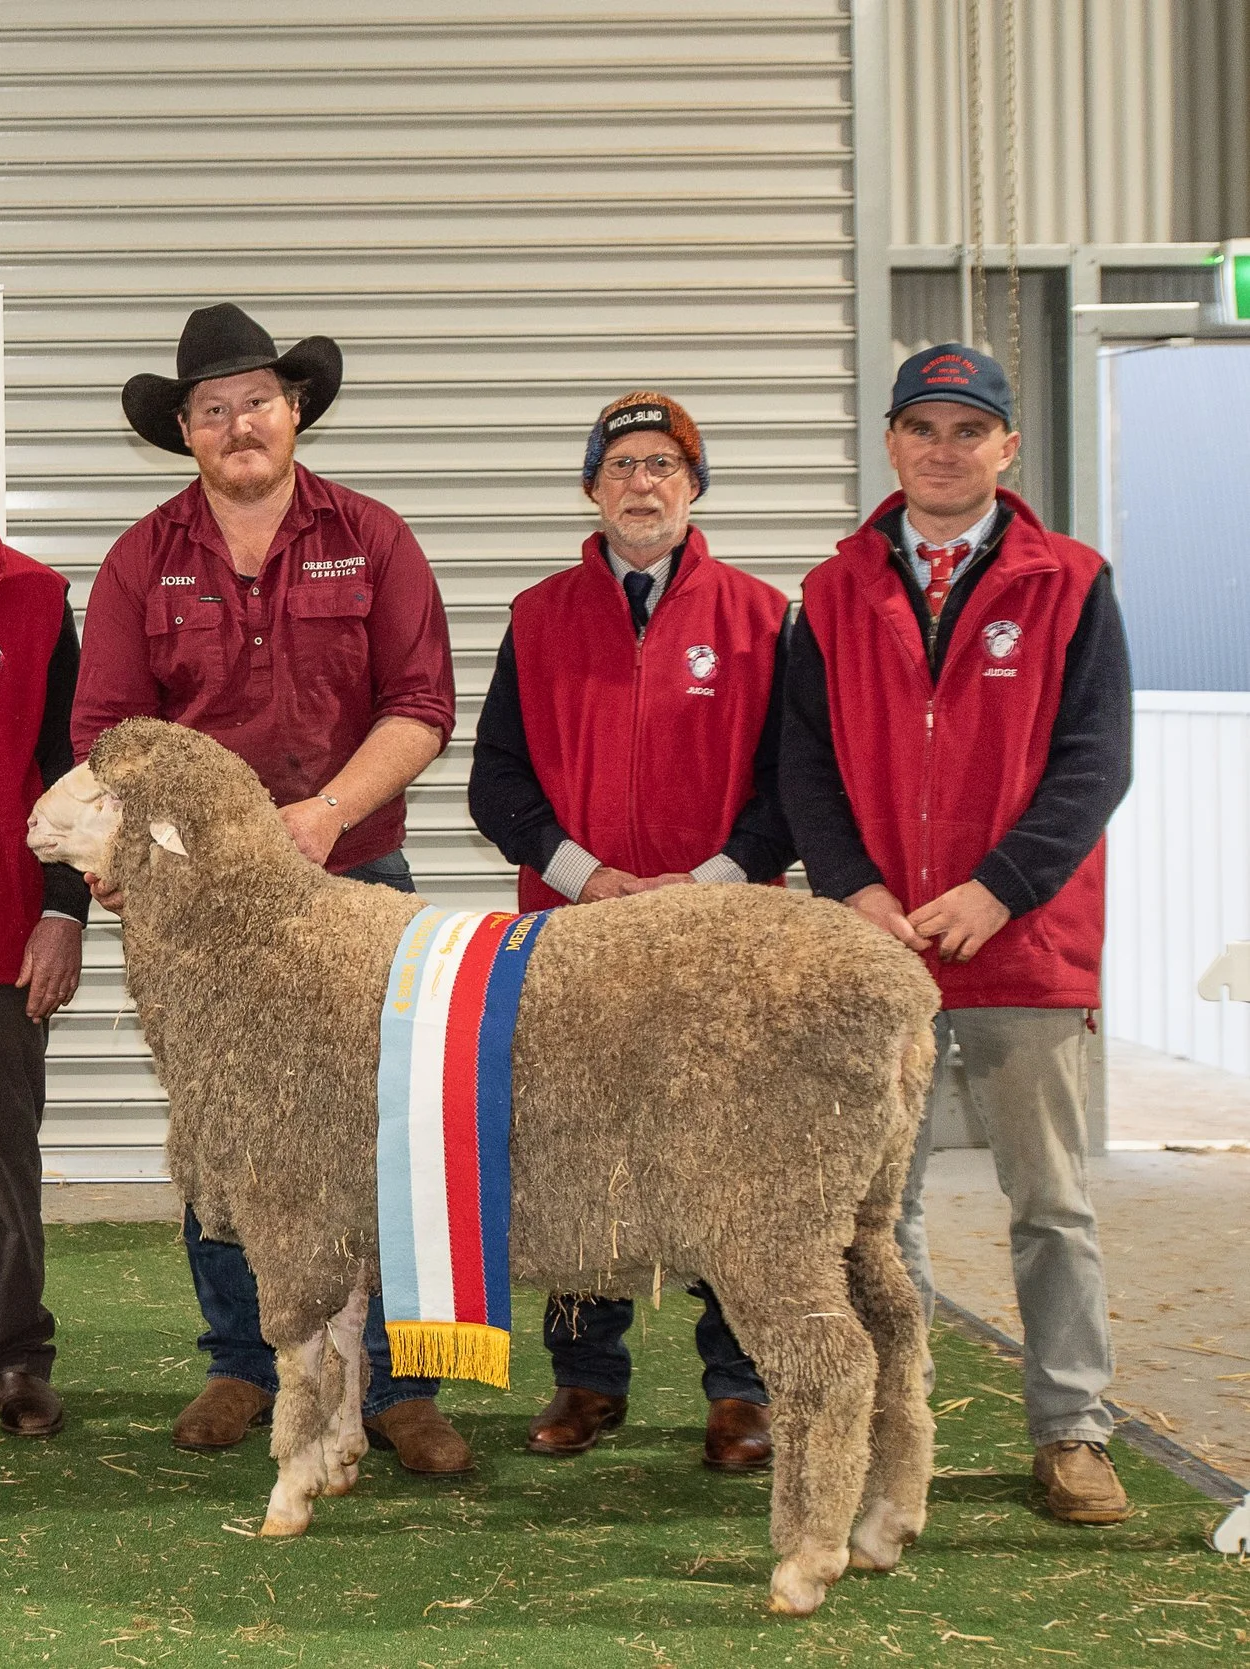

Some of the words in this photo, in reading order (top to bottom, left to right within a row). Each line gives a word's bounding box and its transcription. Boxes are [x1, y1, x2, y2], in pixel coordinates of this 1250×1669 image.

[609, 410, 662, 431] WOOL-BLIND
[303, 559, 333, 571] ORRIE
[335, 556, 366, 568] COWIE
[311, 567, 357, 578] GENETICS
[161, 576, 196, 586] JOHN
[982, 668, 1018, 677] JUDGE
[686, 686, 715, 696] JUDGE
[506, 913, 539, 951] MERINO
